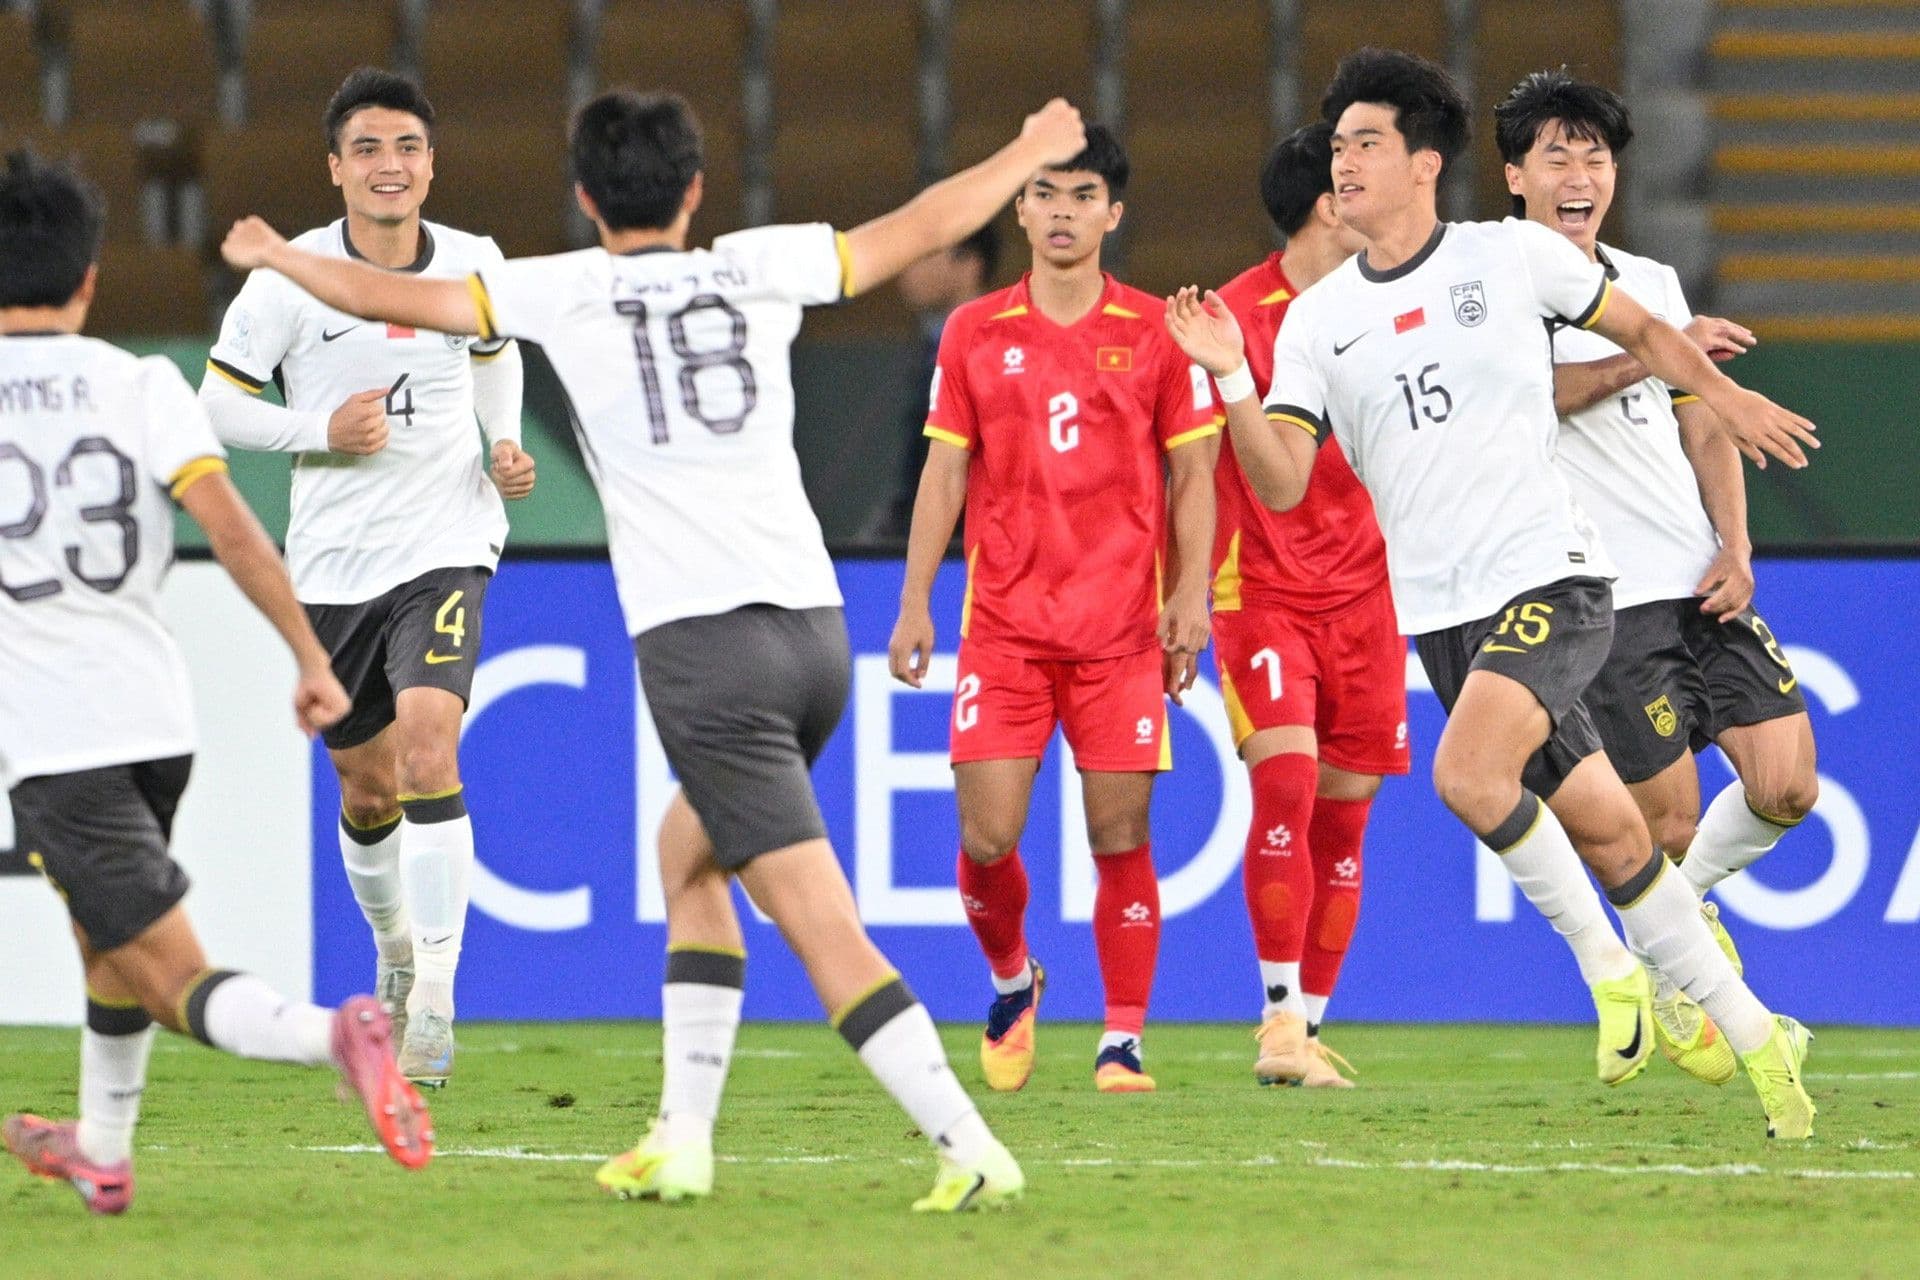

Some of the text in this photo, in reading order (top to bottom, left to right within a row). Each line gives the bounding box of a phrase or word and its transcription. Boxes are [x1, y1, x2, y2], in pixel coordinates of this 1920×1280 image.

[614, 293, 757, 444] 18
[1395, 362, 1453, 430] 15
[386, 373, 415, 426] 4
[1049, 392, 1079, 453] 2
[0, 436, 139, 601] 23
[434, 590, 465, 647] 4
[956, 673, 981, 732] 2
